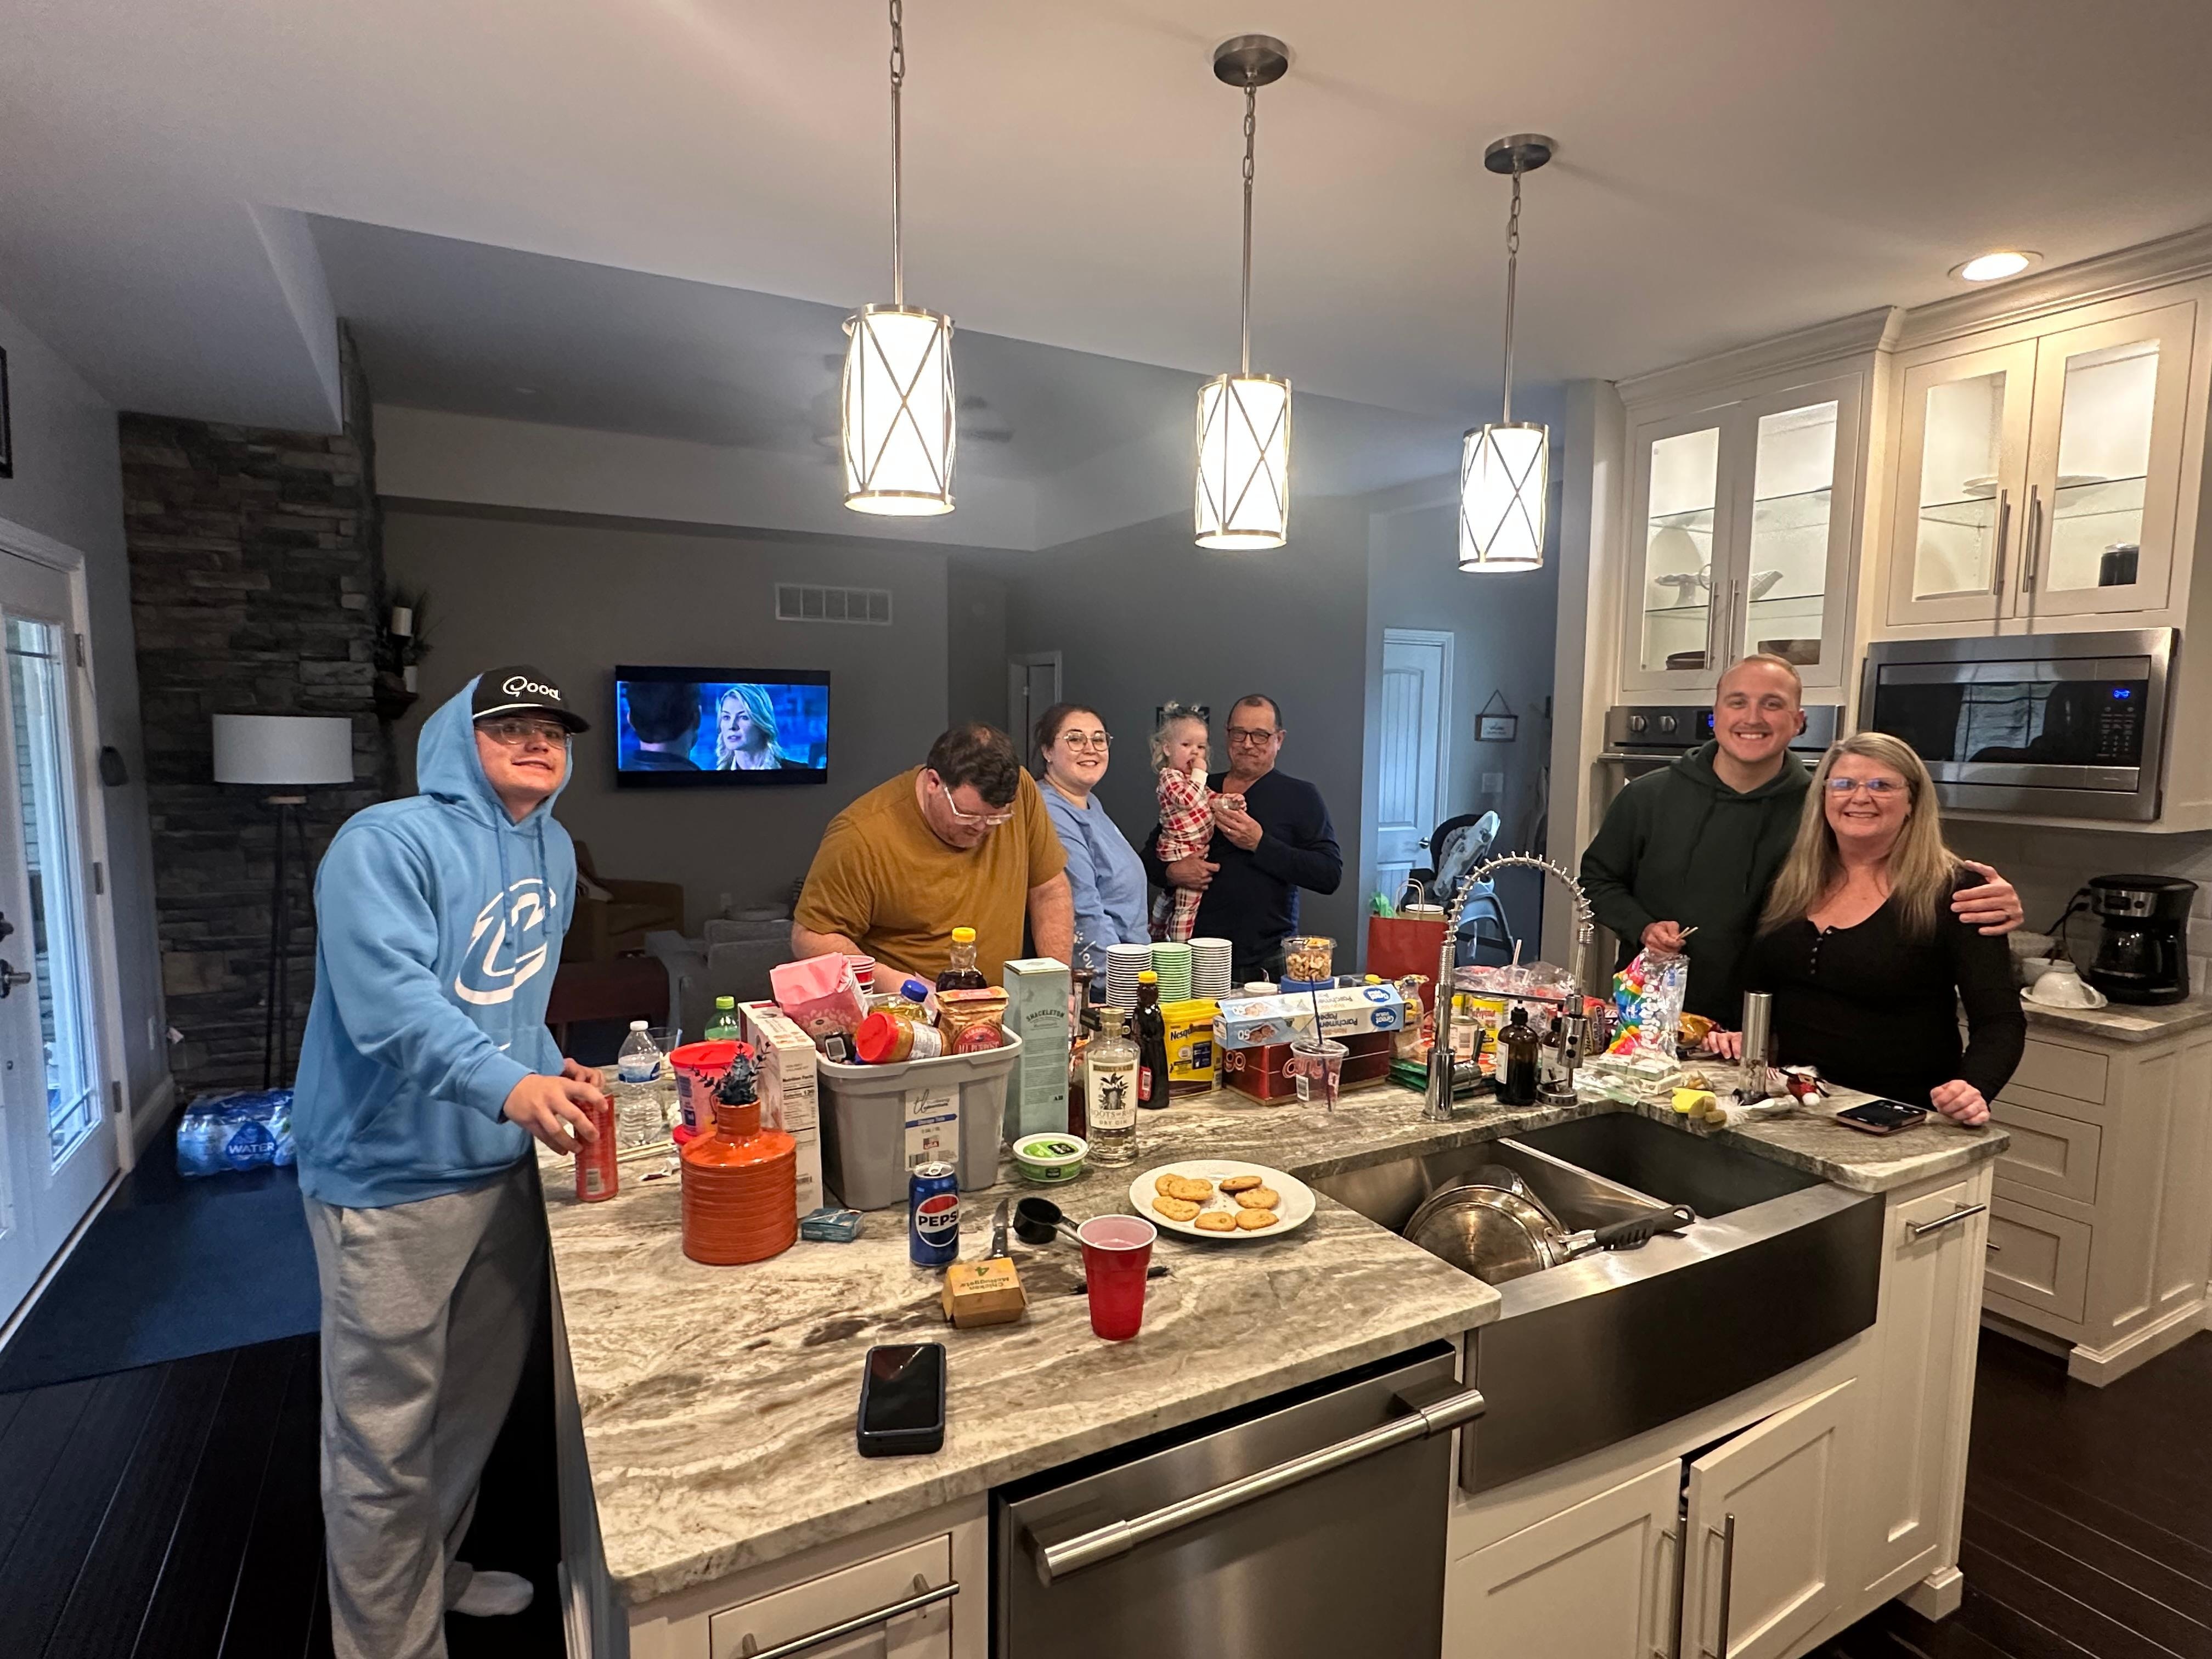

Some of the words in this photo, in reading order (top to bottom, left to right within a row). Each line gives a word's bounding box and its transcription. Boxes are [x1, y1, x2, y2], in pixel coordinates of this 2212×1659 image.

[1025, 1009, 1065, 1023] SHACKLETON
[1321, 1013, 1338, 1021] Pape
[1320, 1018, 1358, 1029] Parchmen
[1170, 1028, 1192, 1041] Nesqu
[228, 1142, 275, 1154] WATER
[975, 1266, 990, 1277] 4
[969, 1282, 1005, 1290] Chicken
